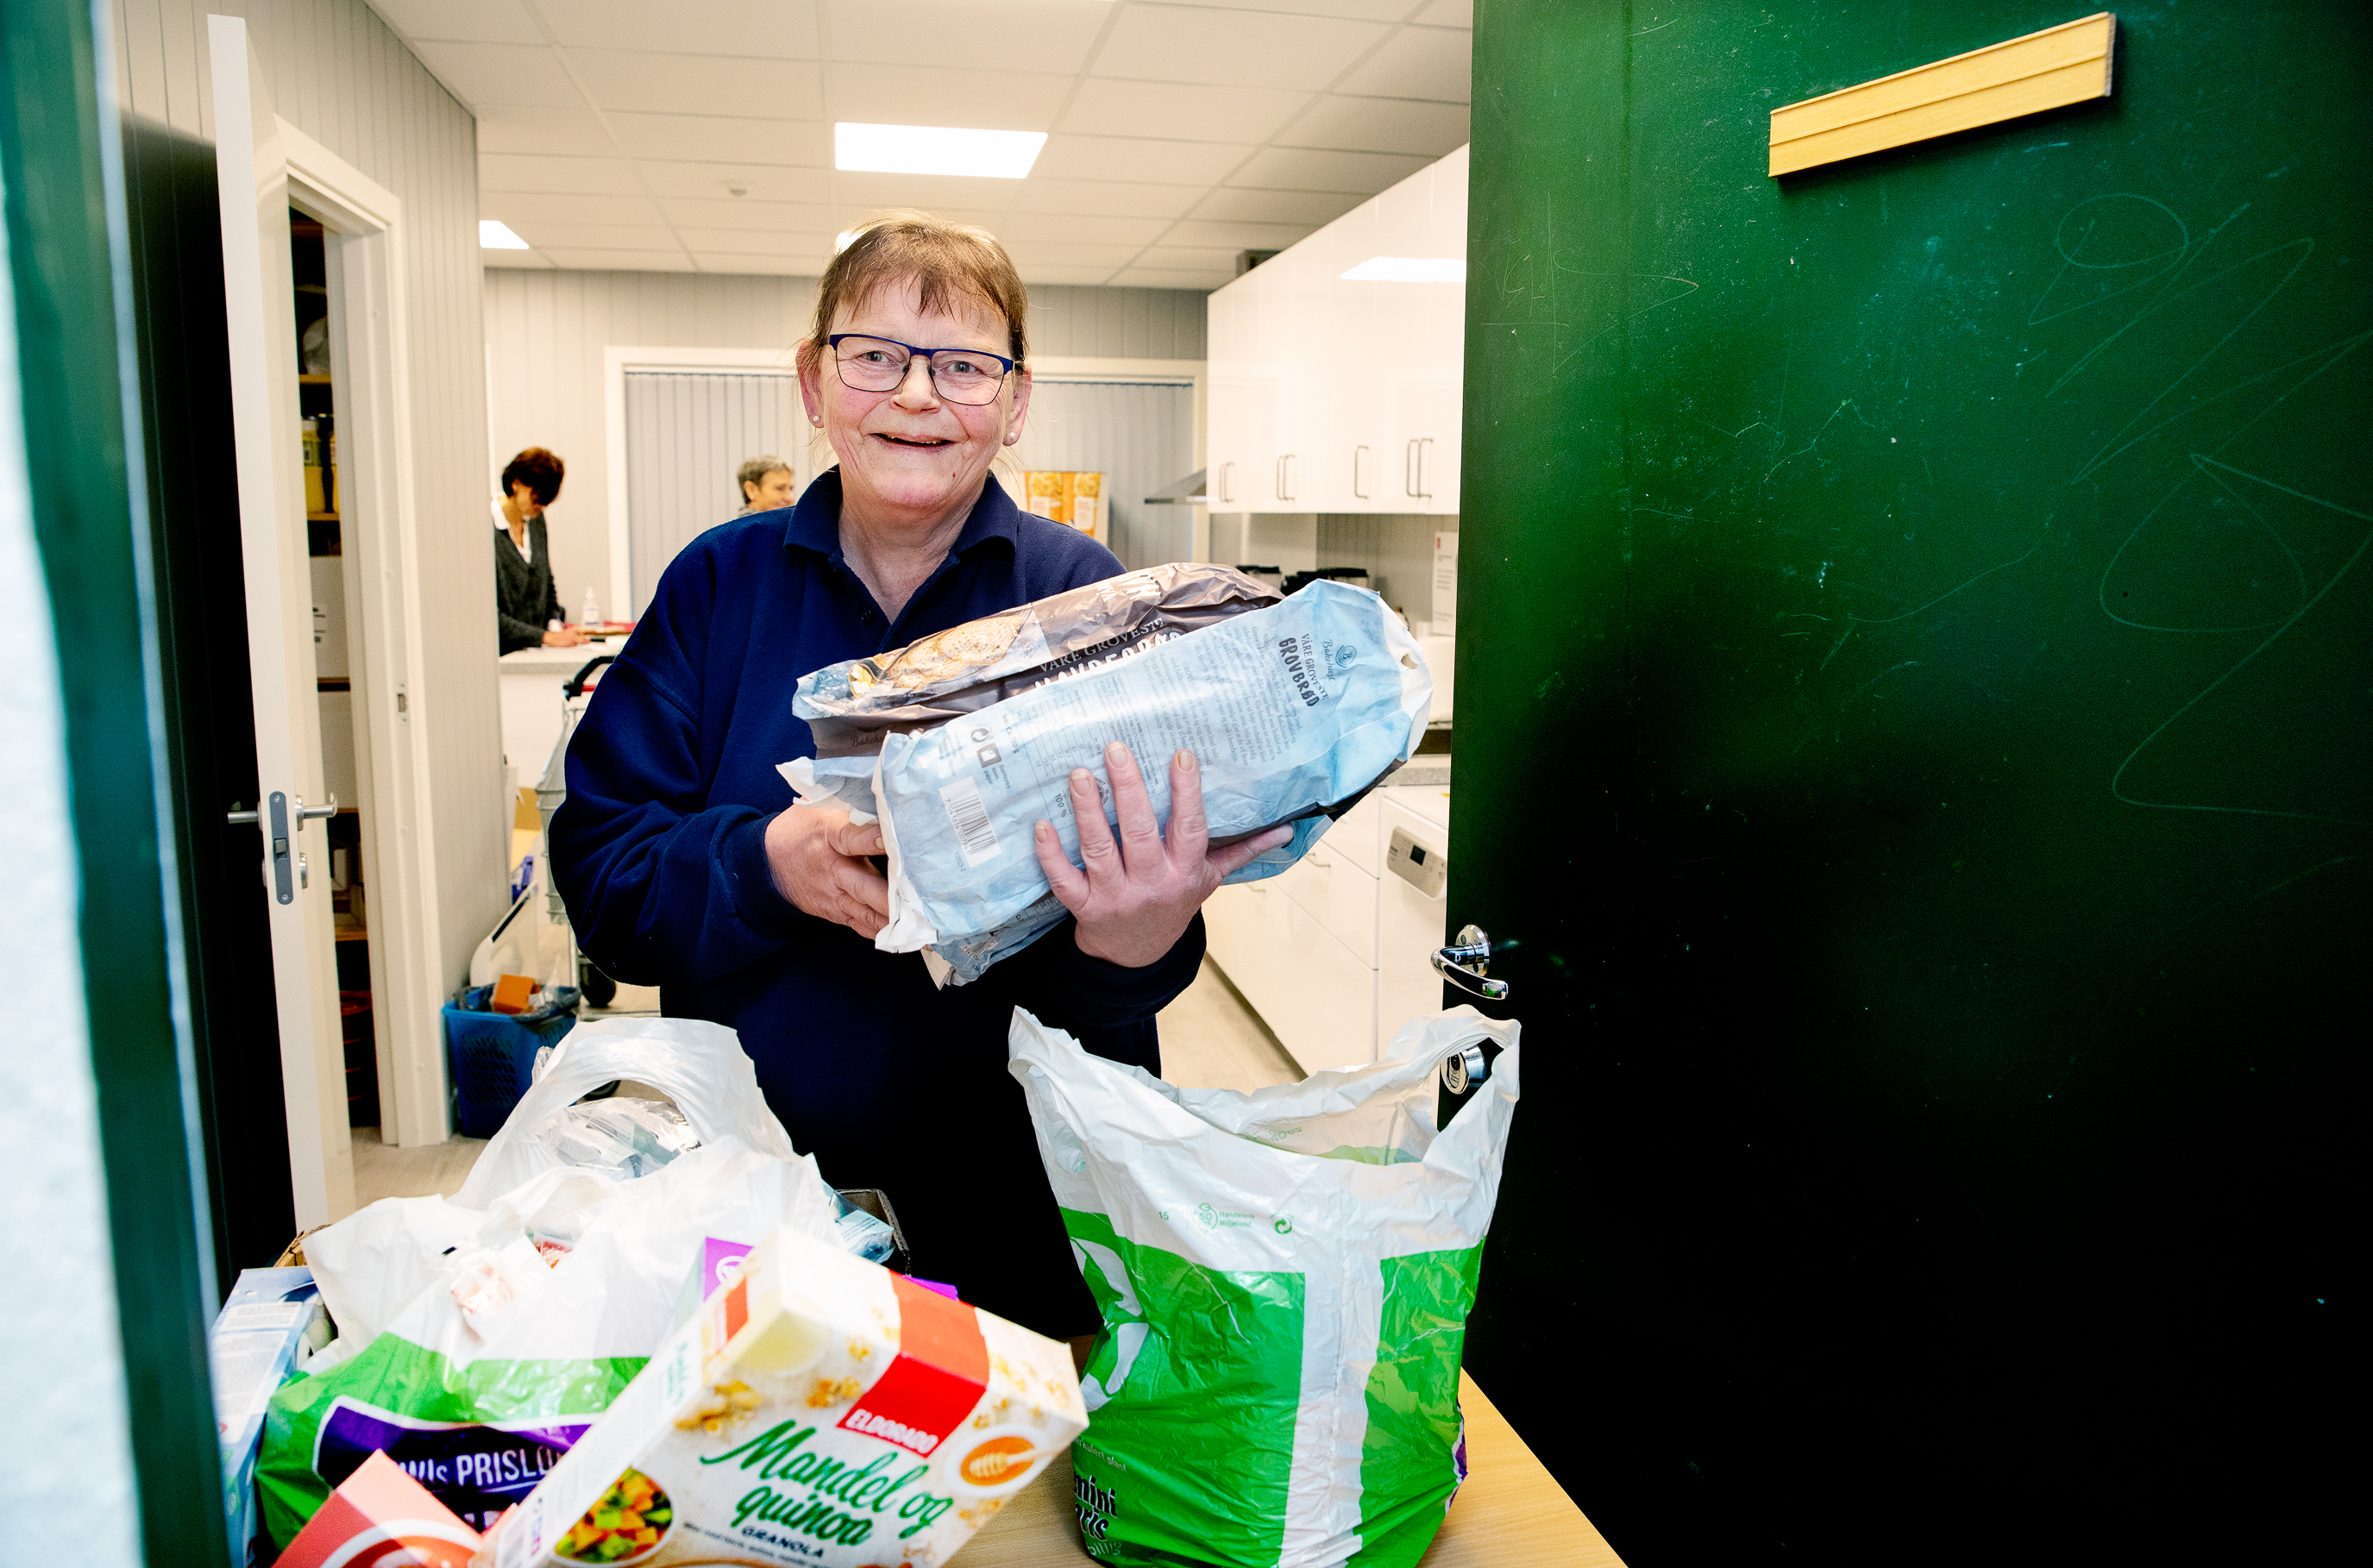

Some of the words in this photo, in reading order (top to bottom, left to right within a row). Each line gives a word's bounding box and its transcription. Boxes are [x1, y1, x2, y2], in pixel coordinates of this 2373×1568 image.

[1302, 633, 1312, 657] VÅRE
[1278, 637, 1320, 706] GROVBRØD
[1305, 658, 1328, 699] GROVESTE
[982, 769, 994, 785] papir
[998, 764, 1012, 788] Sorteres
[1054, 793, 1064, 807] 100
[845, 1408, 939, 1453] ELDORADO
[700, 1419, 929, 1513] Mandel
[898, 1490, 954, 1540] og
[731, 1485, 873, 1546] quinoa
[741, 1525, 825, 1558] GRANOLA
